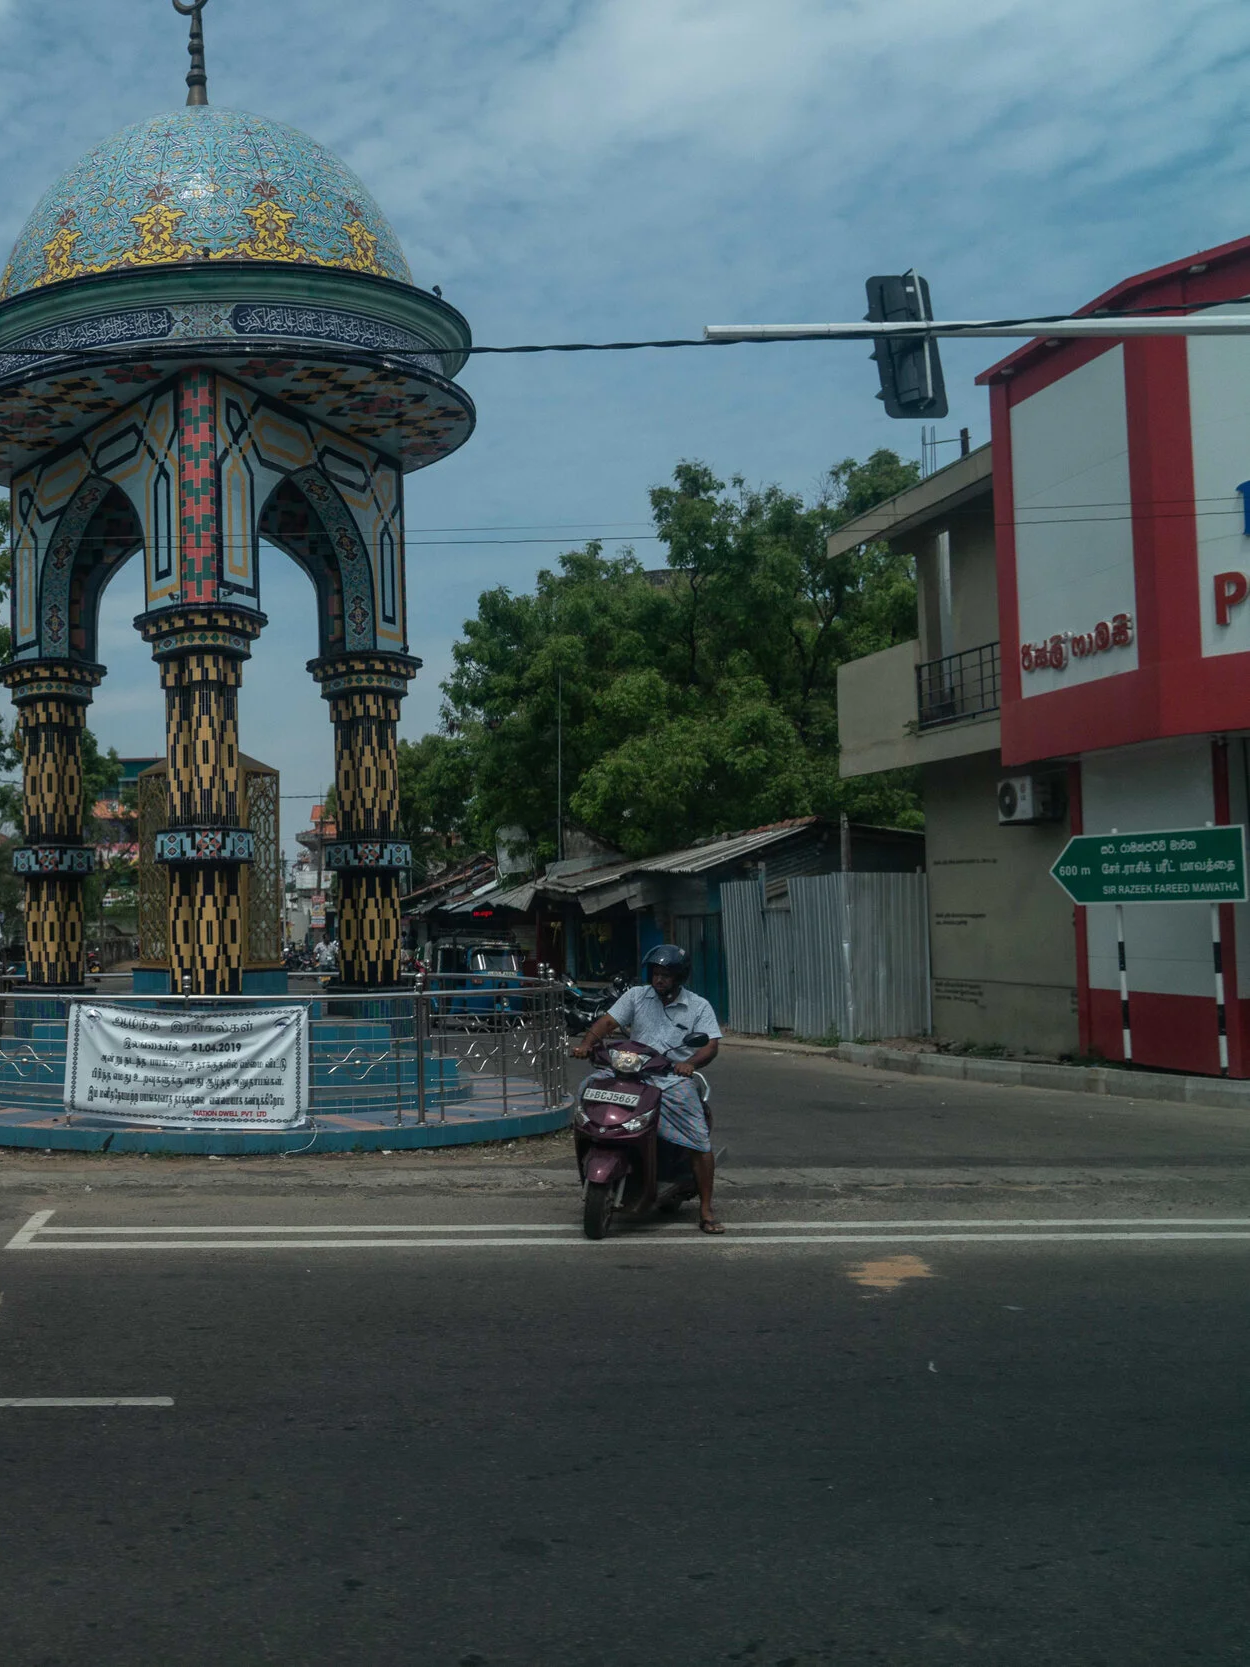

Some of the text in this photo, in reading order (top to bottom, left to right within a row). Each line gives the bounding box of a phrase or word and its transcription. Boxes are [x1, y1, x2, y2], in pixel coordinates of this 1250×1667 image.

[1059, 866, 1091, 876] 600 m
[1102, 882, 1240, 895] SIR RAZEEK FAREED MAWATHA
[112, 1015, 253, 1033] ஆழ்ந்த இரங்கல்கள்
[191, 1042, 242, 1052] 21.04.2019
